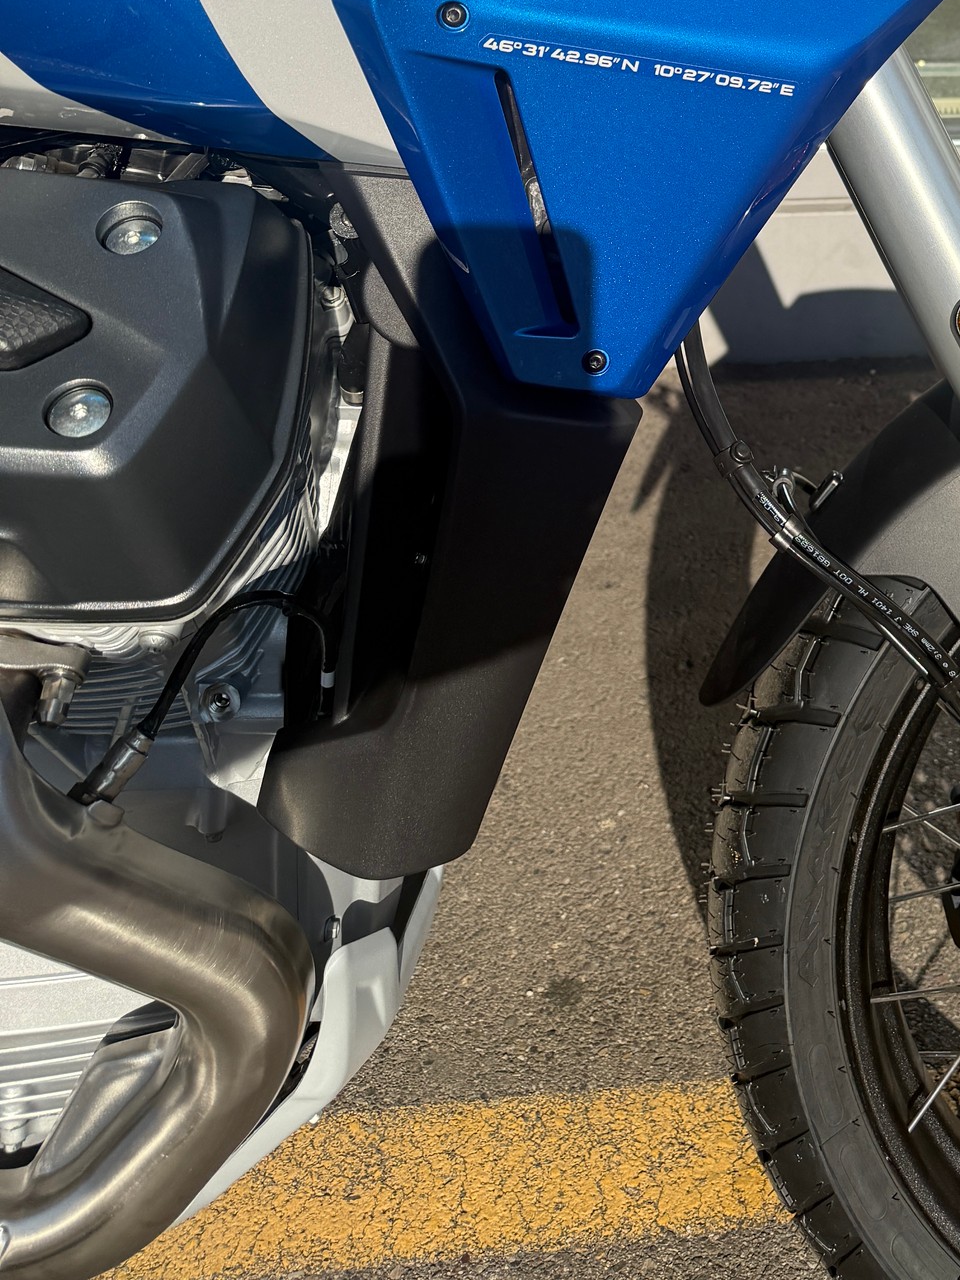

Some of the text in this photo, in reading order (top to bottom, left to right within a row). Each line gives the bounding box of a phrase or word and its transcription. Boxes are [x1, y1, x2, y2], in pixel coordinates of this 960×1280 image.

[833, 569, 853, 585] DOT
[857, 585, 869, 597] HL
[871, 597, 893, 615] 1401
[902, 622, 919, 637] SAE
